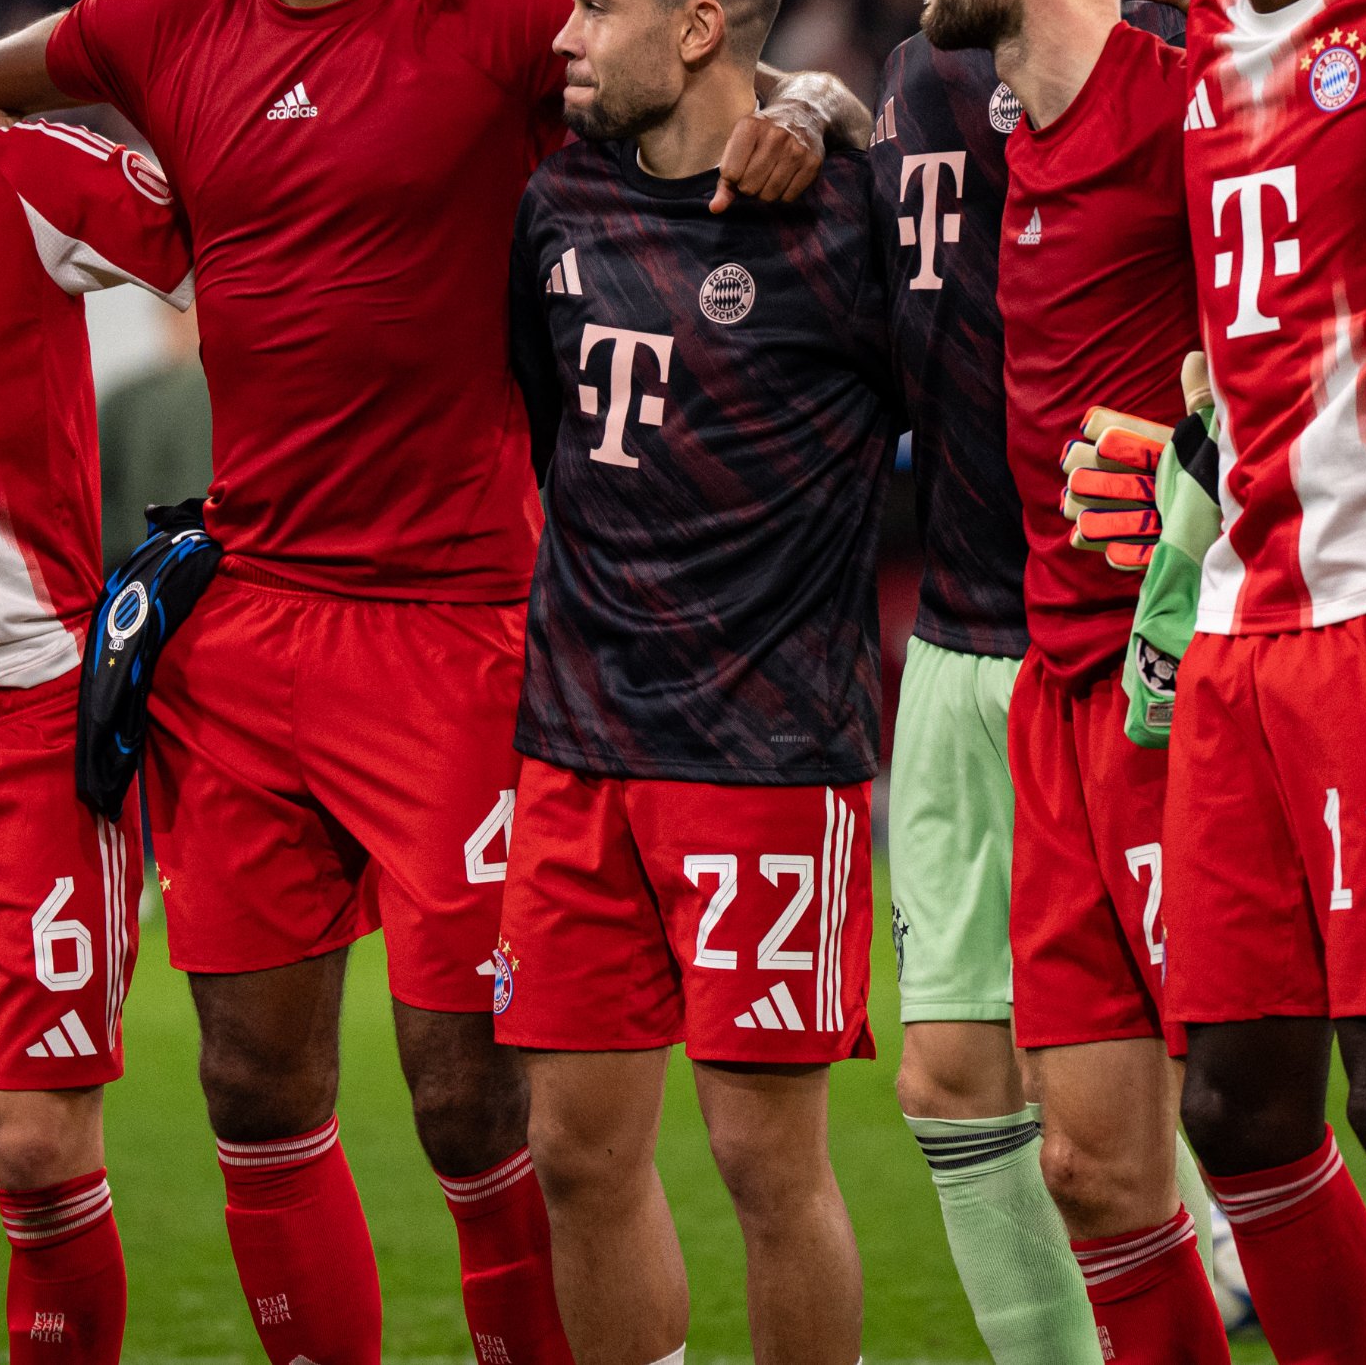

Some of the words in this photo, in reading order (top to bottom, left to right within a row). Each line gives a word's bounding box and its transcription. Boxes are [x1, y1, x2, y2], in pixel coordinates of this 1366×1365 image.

[266, 105, 318, 120] adidas
[898, 151, 966, 290] T
[1212, 165, 1300, 340] T
[709, 274, 720, 287] FC
[722, 269, 751, 293] BAYERN
[578, 323, 673, 469] T
[683, 854, 815, 970] 22
[32, 876, 93, 992] 6
[256, 1294, 286, 1307] MIA
[35, 1312, 64, 1323] MIA
[262, 1312, 292, 1325] MIA
[30, 1330, 61, 1343] MIA
[476, 1332, 504, 1346] MIA
[483, 1354, 512, 1364] MIA
